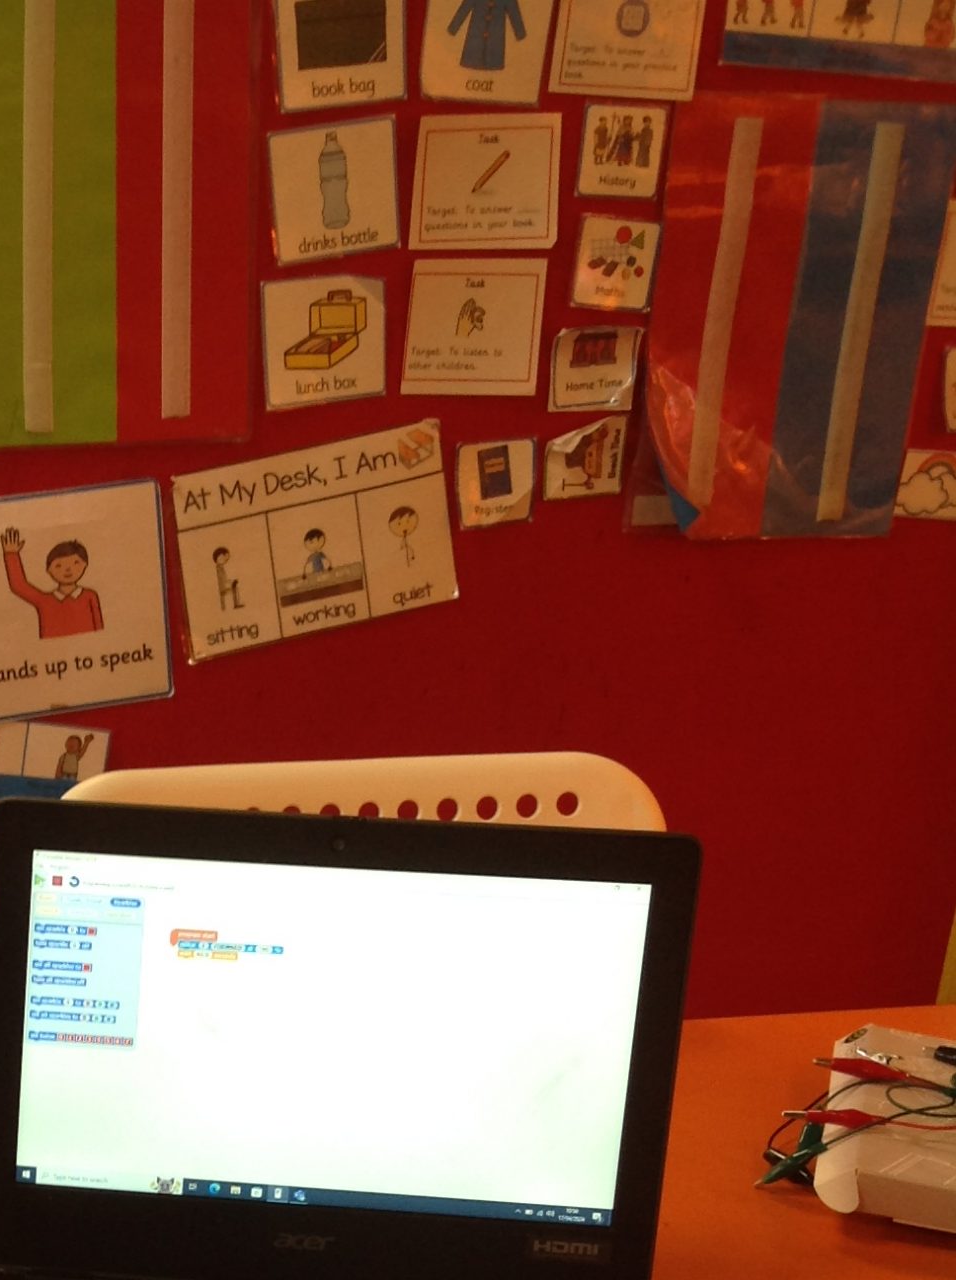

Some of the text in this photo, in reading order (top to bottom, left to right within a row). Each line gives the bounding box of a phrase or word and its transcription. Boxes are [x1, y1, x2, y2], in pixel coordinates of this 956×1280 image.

[311, 77, 376, 98] book bag
[465, 79, 494, 93] coat
[599, 176, 637, 189] History
[466, 204, 475, 214] To
[479, 206, 512, 215] answer
[424, 222, 468, 232] questions
[487, 221, 508, 231] your
[298, 227, 379, 254] drinks bottle
[449, 346, 459, 356] To
[463, 347, 489, 357] listen
[493, 348, 502, 357] to
[408, 361, 432, 370] other
[296, 375, 357, 395] lunch box
[565, 378, 624, 392] Home Time
[183, 450, 397, 514] At My Desk, I Am
[392, 581, 434, 607] quiet
[292, 602, 357, 627] working
[206, 622, 260, 647] sitting
[45, 660, 68, 680] up
[74, 656, 94, 671] to
[100, 643, 154, 672] speak
[274, 1232, 335, 1251] acer
[533, 1240, 598, 1256] HDMI
